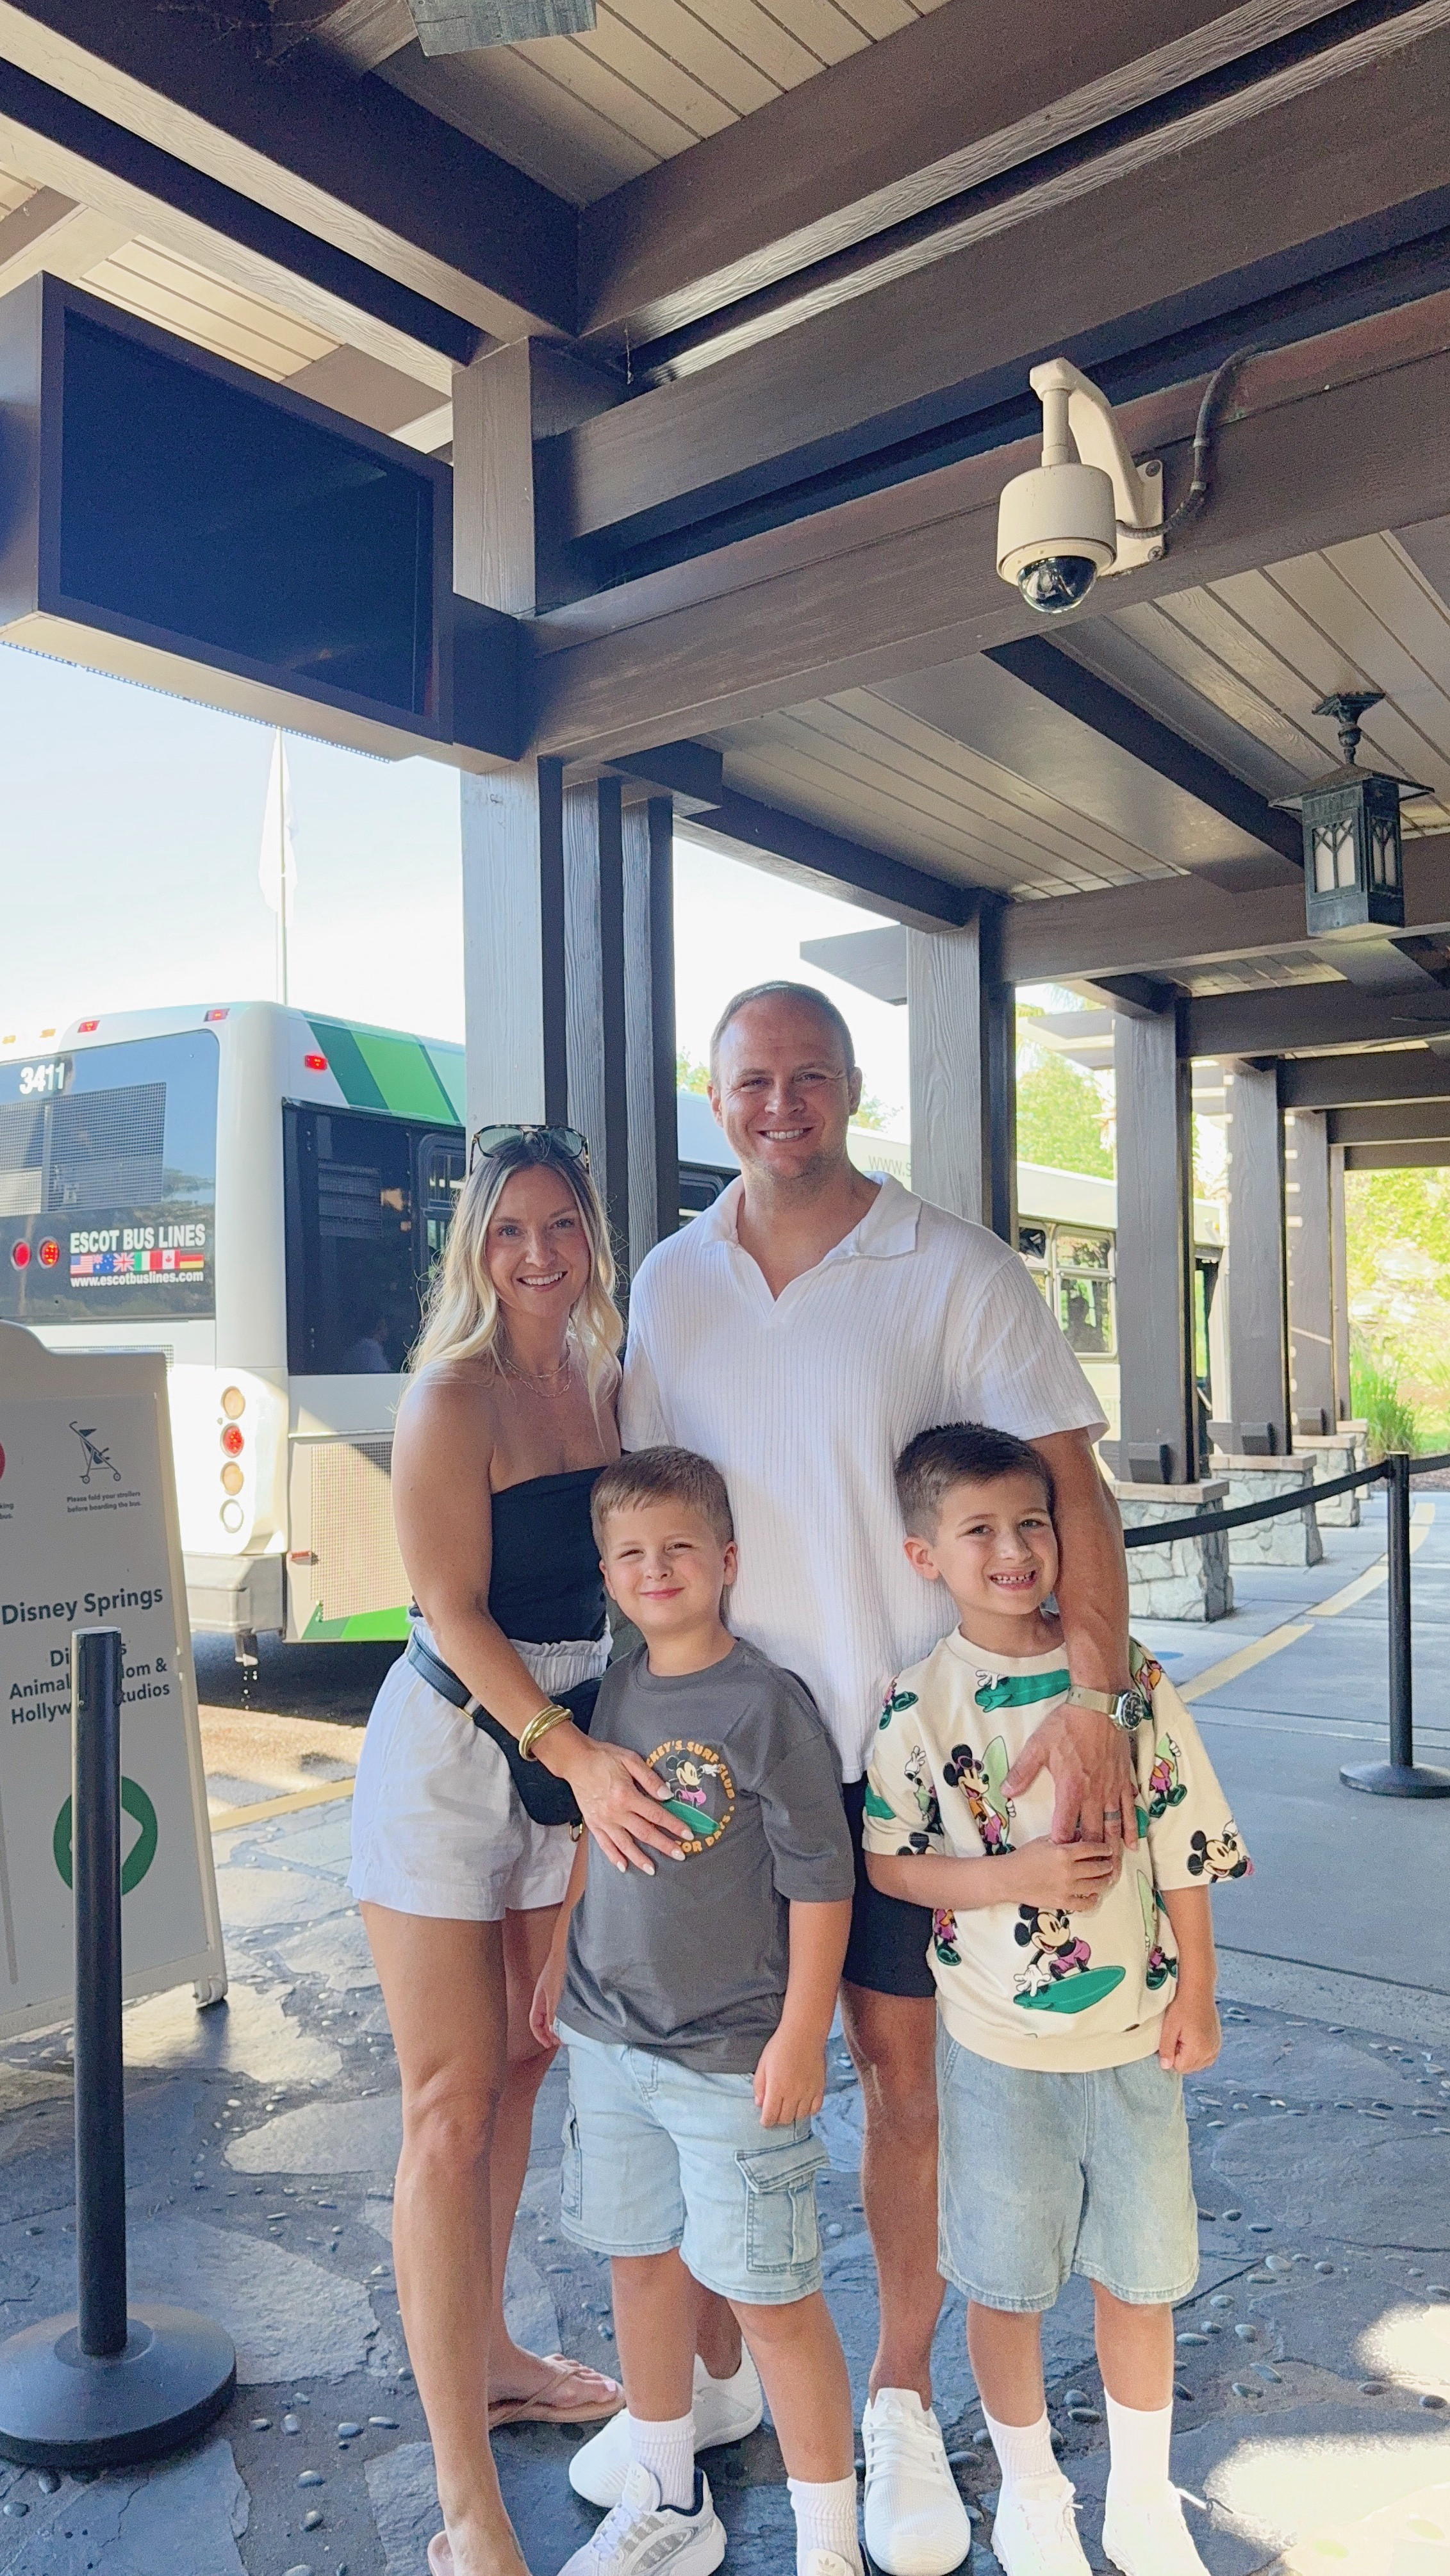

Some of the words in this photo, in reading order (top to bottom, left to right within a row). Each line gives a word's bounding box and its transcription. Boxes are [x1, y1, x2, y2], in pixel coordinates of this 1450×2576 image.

[19, 1062, 65, 1094] 3411
[70, 1230, 120, 1253] ESCOT
[123, 1227, 154, 1250] BUS
[159, 1224, 206, 1248] LINES
[70, 1271, 204, 1287] www.escotbuslines.com
[89, 1503, 117, 1511] boarding
[1, 1600, 78, 1625] Disney
[84, 1588, 163, 1617] Springs
[10, 1673, 71, 1699] Animal
[156, 1657, 167, 1672] &
[12, 1702, 72, 1724] Hollyw
[122, 1683, 170, 1703] tudios
[646, 1740, 682, 1768] CKEY'S
[686, 1741, 719, 1763] SURF
[675, 1840, 702, 1853] OR
